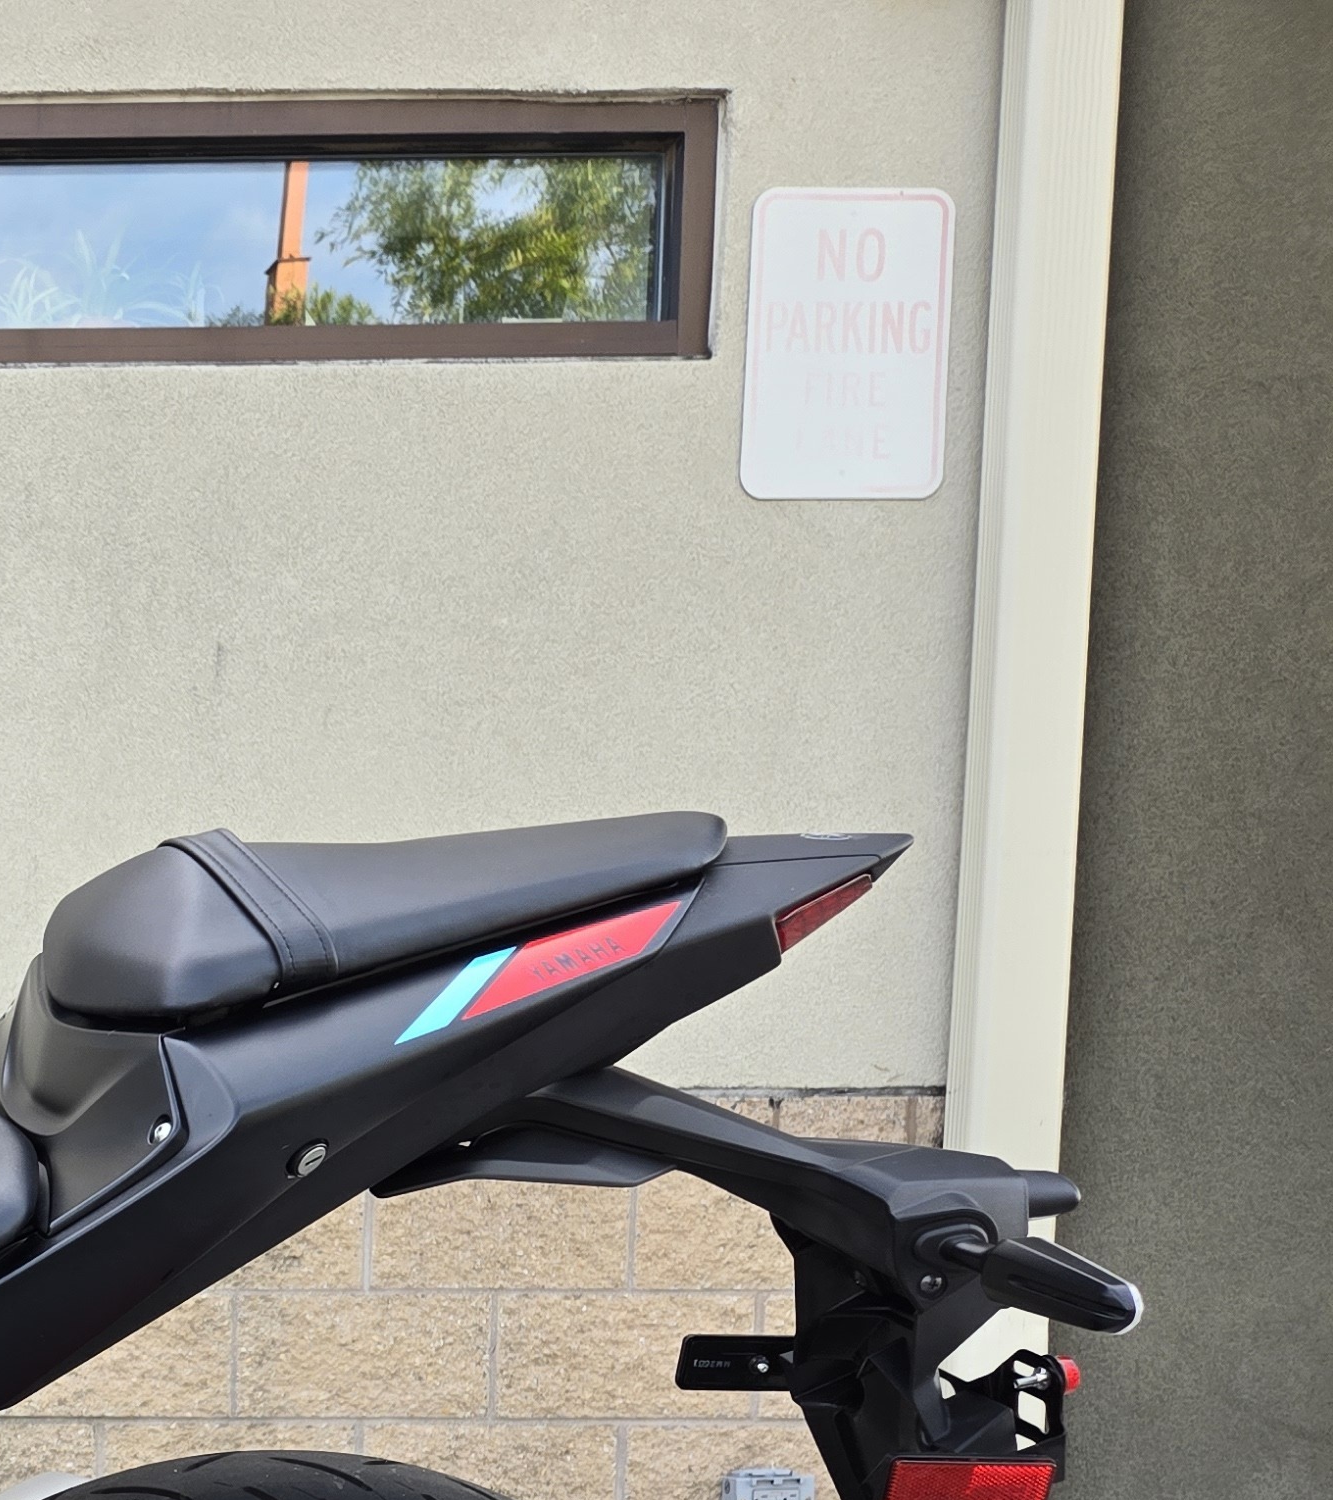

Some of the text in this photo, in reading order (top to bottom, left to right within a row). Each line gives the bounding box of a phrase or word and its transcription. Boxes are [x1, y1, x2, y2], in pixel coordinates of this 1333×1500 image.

[816, 227, 886, 283] NO
[765, 299, 933, 355] PARKING
[803, 370, 888, 409] FIRE
[531, 936, 625, 982] YAMAHA
